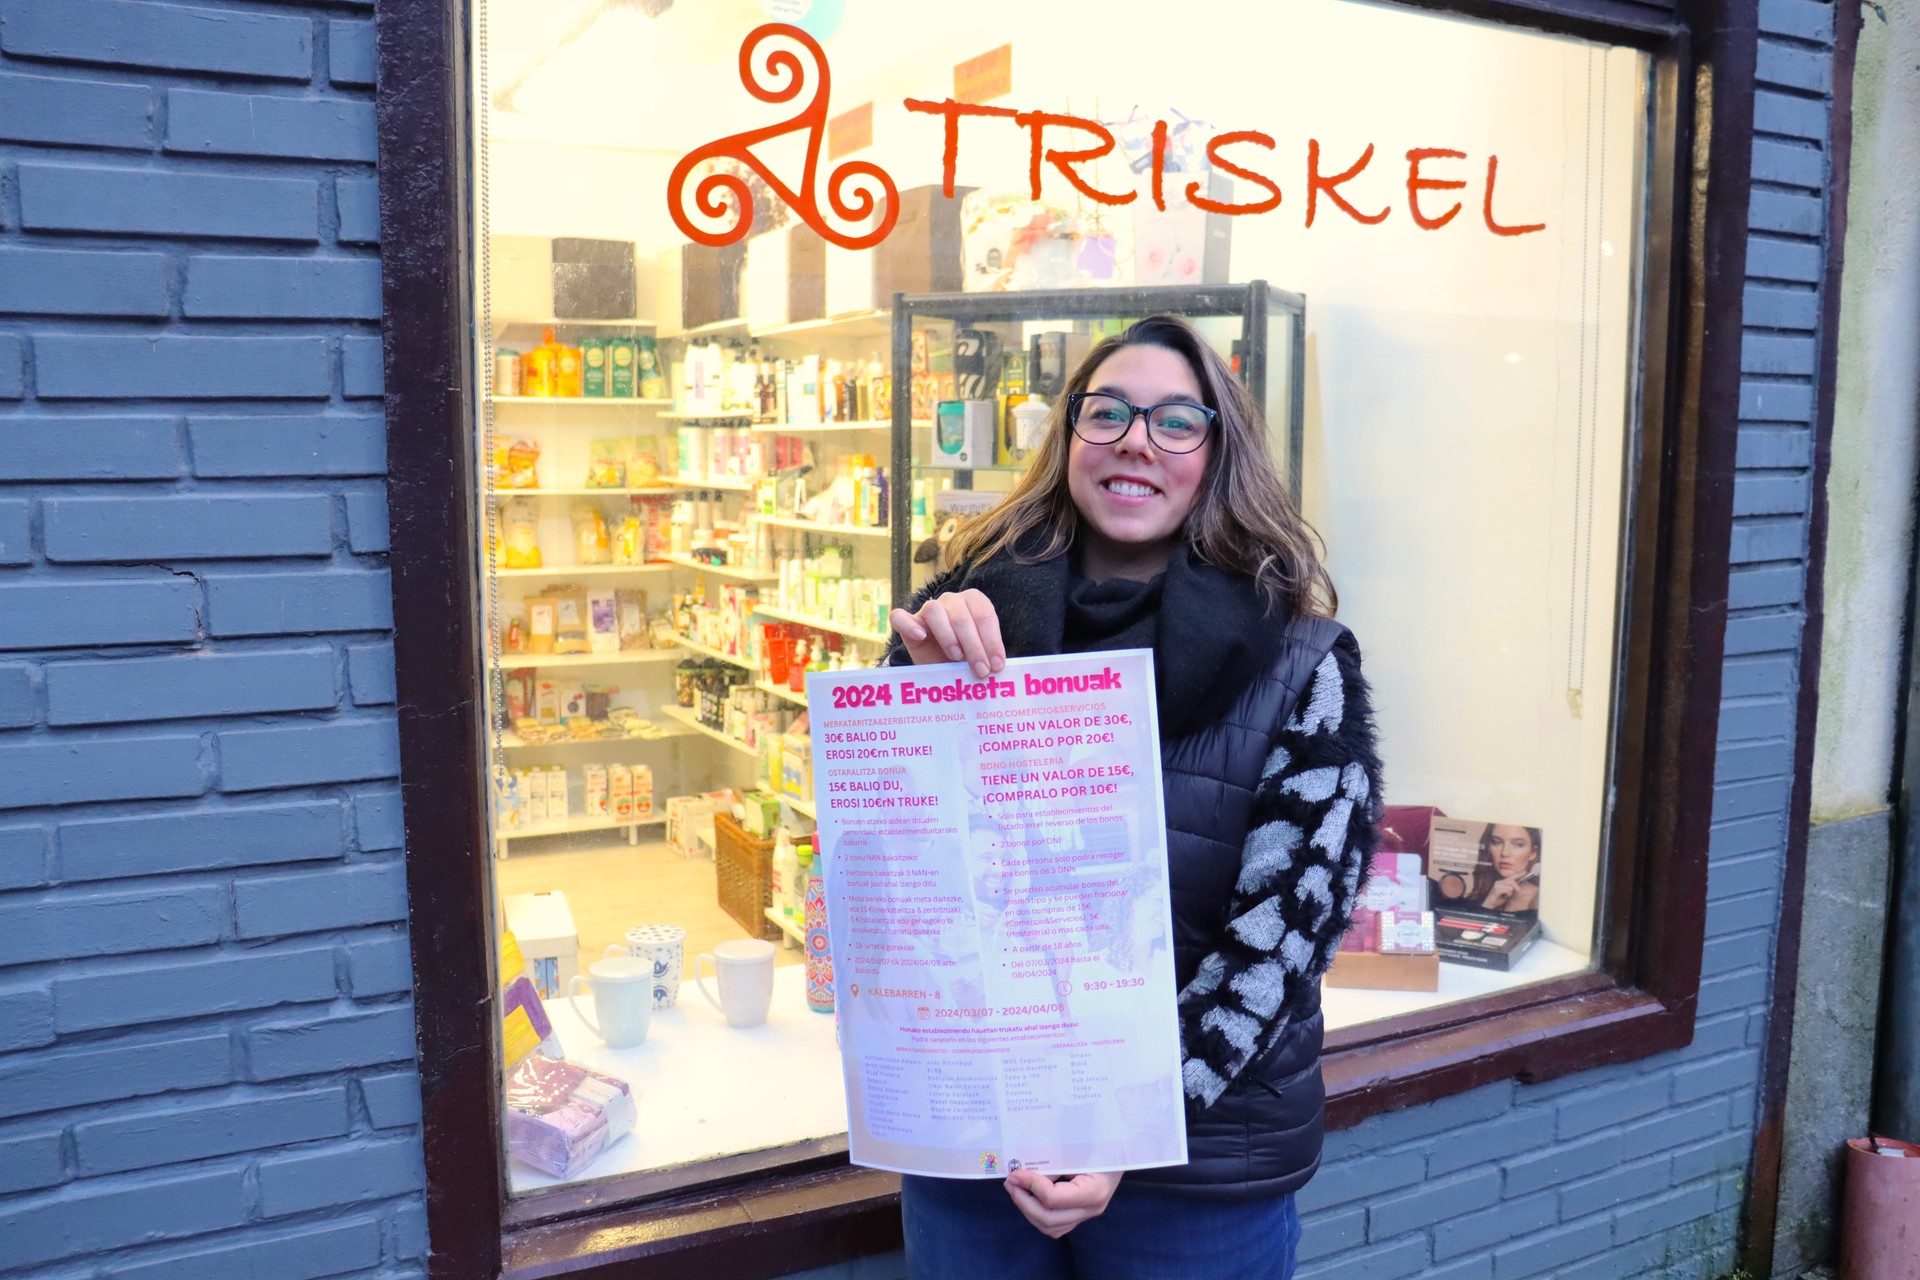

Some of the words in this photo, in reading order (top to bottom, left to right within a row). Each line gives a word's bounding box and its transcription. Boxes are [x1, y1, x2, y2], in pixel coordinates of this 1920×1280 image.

[904, 97, 1546, 236] TRISKEL
[832, 684, 892, 709] 2024
[900, 676, 1015, 704] Erosketa
[1024, 667, 1122, 696] bonuak
[976, 712, 1002, 720] BONO
[1005, 702, 1106, 717] COMERCIO&SERVICIOS
[824, 715, 933, 728] MERKATARITZA&ZERBITZUAK
[935, 713, 966, 722] BONUA
[977, 723, 1014, 736] TIENE
[1017, 722, 1036, 732] UN
[1038, 718, 1081, 730] VALOR
[1084, 716, 1101, 727] DE
[1104, 714, 1132, 726] 30€,
[824, 732, 844, 744] 30€
[846, 731, 878, 742] BALIO
[880, 730, 896, 740] DU
[978, 737, 1054, 754] ¡COMPRALO
[1058, 735, 1084, 746] POR
[1086, 732, 1114, 744] 20€!
[826, 750, 856, 760] EROSI
[857, 748, 889, 759] 20€rn
[892, 746, 932, 757] TRUKE!
[980, 762, 1006, 770] BONO
[1009, 757, 1064, 768] HOSTELERIA
[828, 768, 876, 776] OSTARALITZA
[878, 766, 907, 776] BONUA
[980, 774, 1018, 786] TIENE
[1020, 772, 1039, 784] UN
[1042, 768, 1084, 782] VALOR
[1088, 766, 1104, 778] DE
[1108, 764, 1134, 777] 15€,
[829, 782, 847, 792] 15€
[850, 781, 880, 792] BALIO
[884, 780, 903, 792] DU,
[982, 788, 1058, 806] ¡COMPRALO
[1061, 786, 1087, 796] POR
[1090, 784, 1118, 795] 10€!
[830, 798, 860, 808] EROSI
[862, 797, 895, 808] 10€rN
[898, 796, 939, 807] TRUKE!
[1016, 812, 1033, 820] para
[1034, 806, 1100, 817] establecimientos
[1101, 804, 1113, 812] del
[912, 816, 938, 824] dauden
[878, 826, 957, 836] establezimenduetarako
[998, 823, 1024, 831] listado
[1022, 858, 1053, 866] persona
[1072, 854, 1095, 862] podra
[1096, 852, 1125, 860] recoger
[1002, 870, 1014, 878] los
[899, 881, 921, 889] izango
[1014, 885, 1043, 895] pueden
[1045, 883, 1079, 892] acumular
[1082, 881, 1104, 889] bonos
[1031, 897, 1046, 905] tipo
[1064, 893, 1093, 902] pueden
[1032, 907, 1064, 915] compras
[1020, 945, 1040, 953] partir
[1026, 957, 1069, 967] 07/03/2024
[1071, 955, 1092, 963] hasta
[1012, 969, 1057, 979] 08/04/2024
[1084, 981, 1107, 991] 9:30
[1116, 978, 1144, 988] 19:30
[868, 988, 926, 999] KALEBARREN
[935, 991, 941, 999] 8
[935, 1008, 994, 1018] 2024/03/07
[1002, 1003, 1065, 1016] 2024/04/08
[1040, 1023, 1060, 1031] izango
